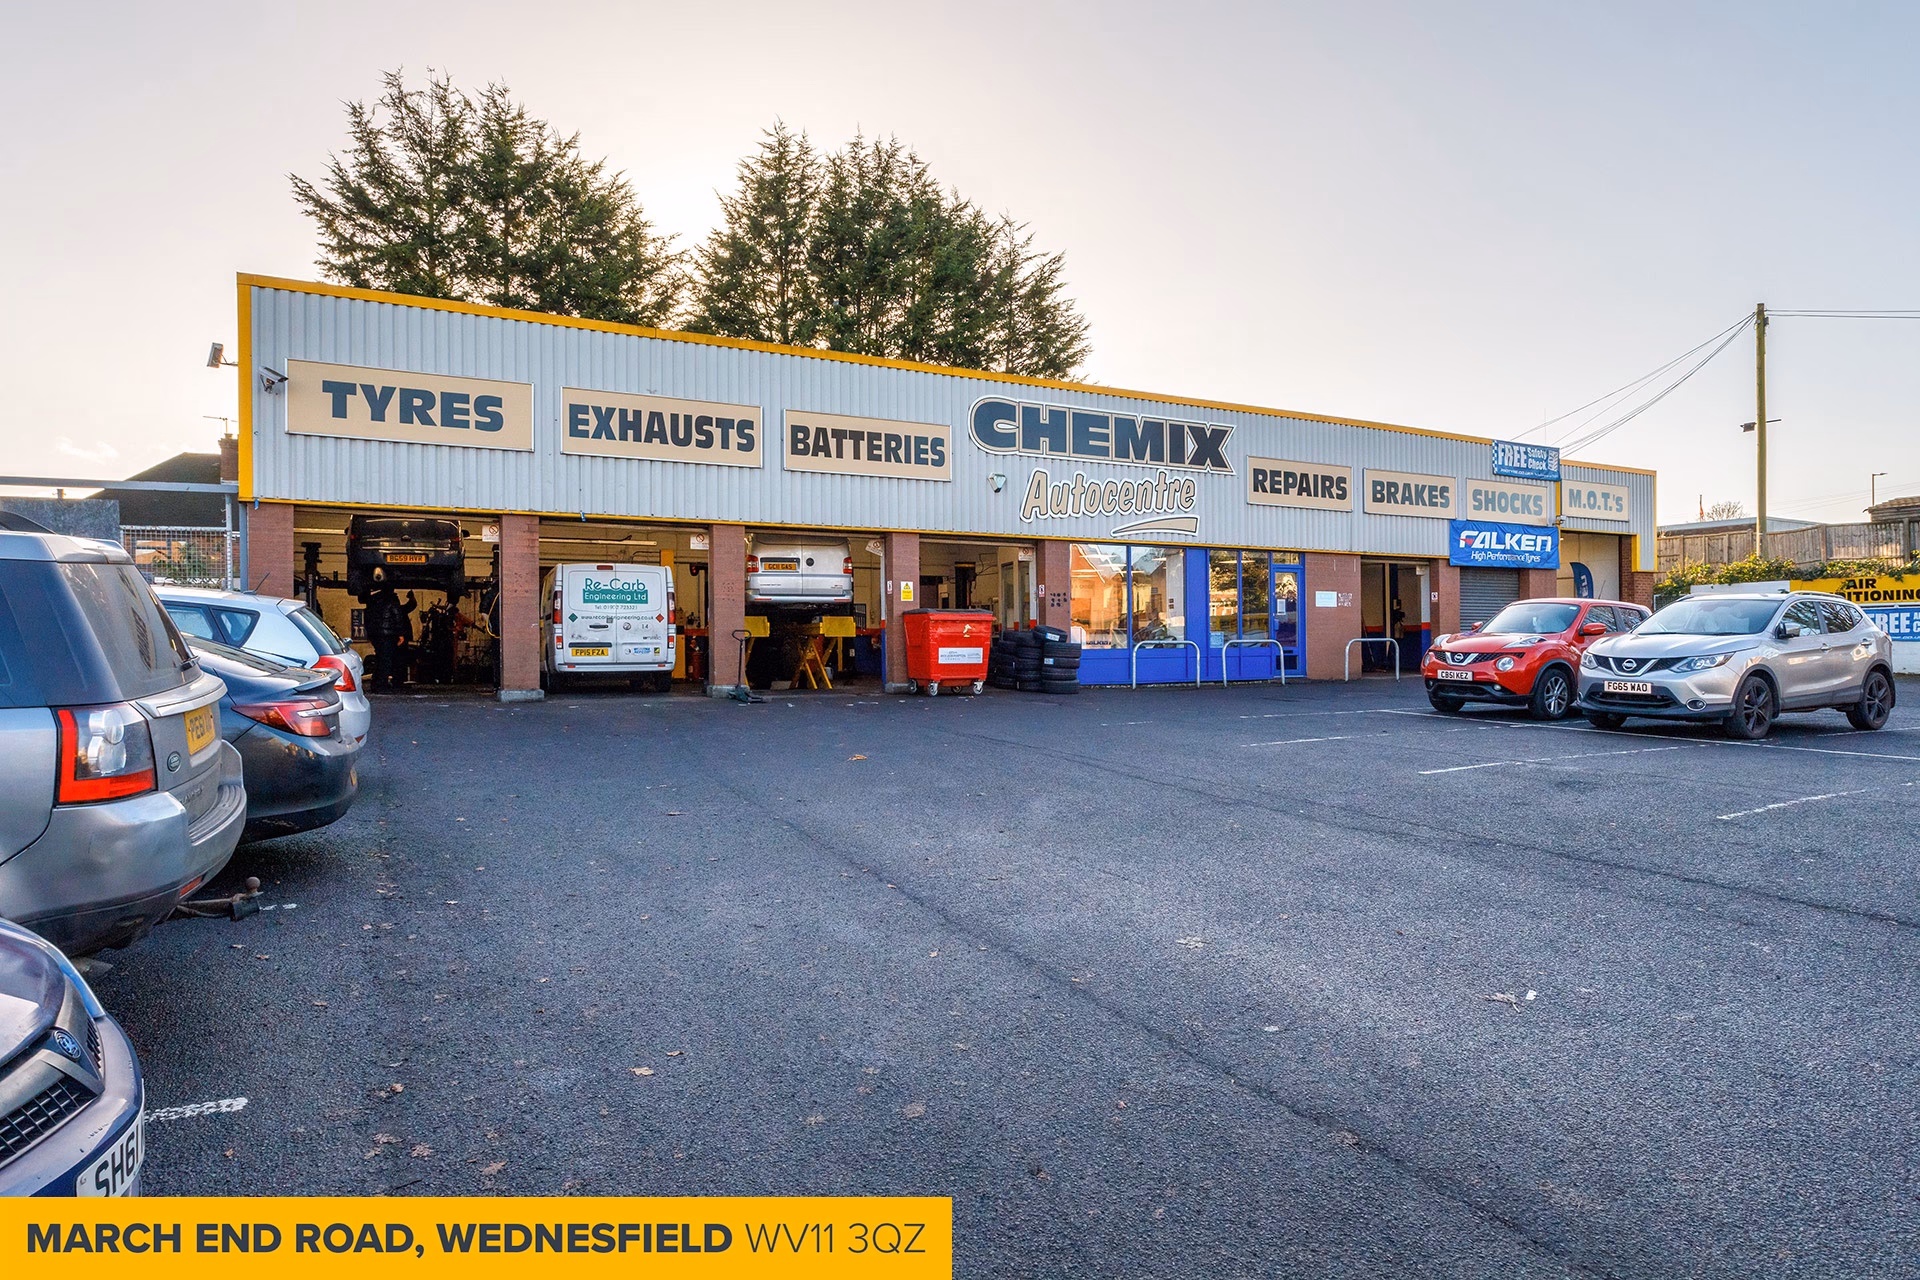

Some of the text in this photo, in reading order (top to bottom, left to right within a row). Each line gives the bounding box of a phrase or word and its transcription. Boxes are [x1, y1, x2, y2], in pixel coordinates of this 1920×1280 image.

[321, 379, 505, 434] TYRES
[568, 403, 755, 453] EXHAUSTS
[970, 398, 1234, 473] CHEMIX
[790, 424, 946, 468] BATTERIES
[1498, 443, 1527, 469] FREE
[1527, 447, 1547, 460] Safety
[1527, 458, 1547, 471] Check
[1022, 470, 1196, 519] Autocentre
[1252, 467, 1348, 501] REPAIRS
[1371, 479, 1450, 509] BRAKES
[1471, 488, 1544, 517] SHOCKS
[1459, 530, 1552, 553] FALKEN
[1471, 550, 1541, 564] High Performance Tyres
[584, 577, 646, 591] Re-Carb
[1845, 578, 1877, 590] AIR
[584, 592, 647, 601] Engineering Ltd
[592, 648, 605, 656] FZA
[1455, 672, 1469, 680] KEZ
[1607, 682, 1629, 691] FG65
